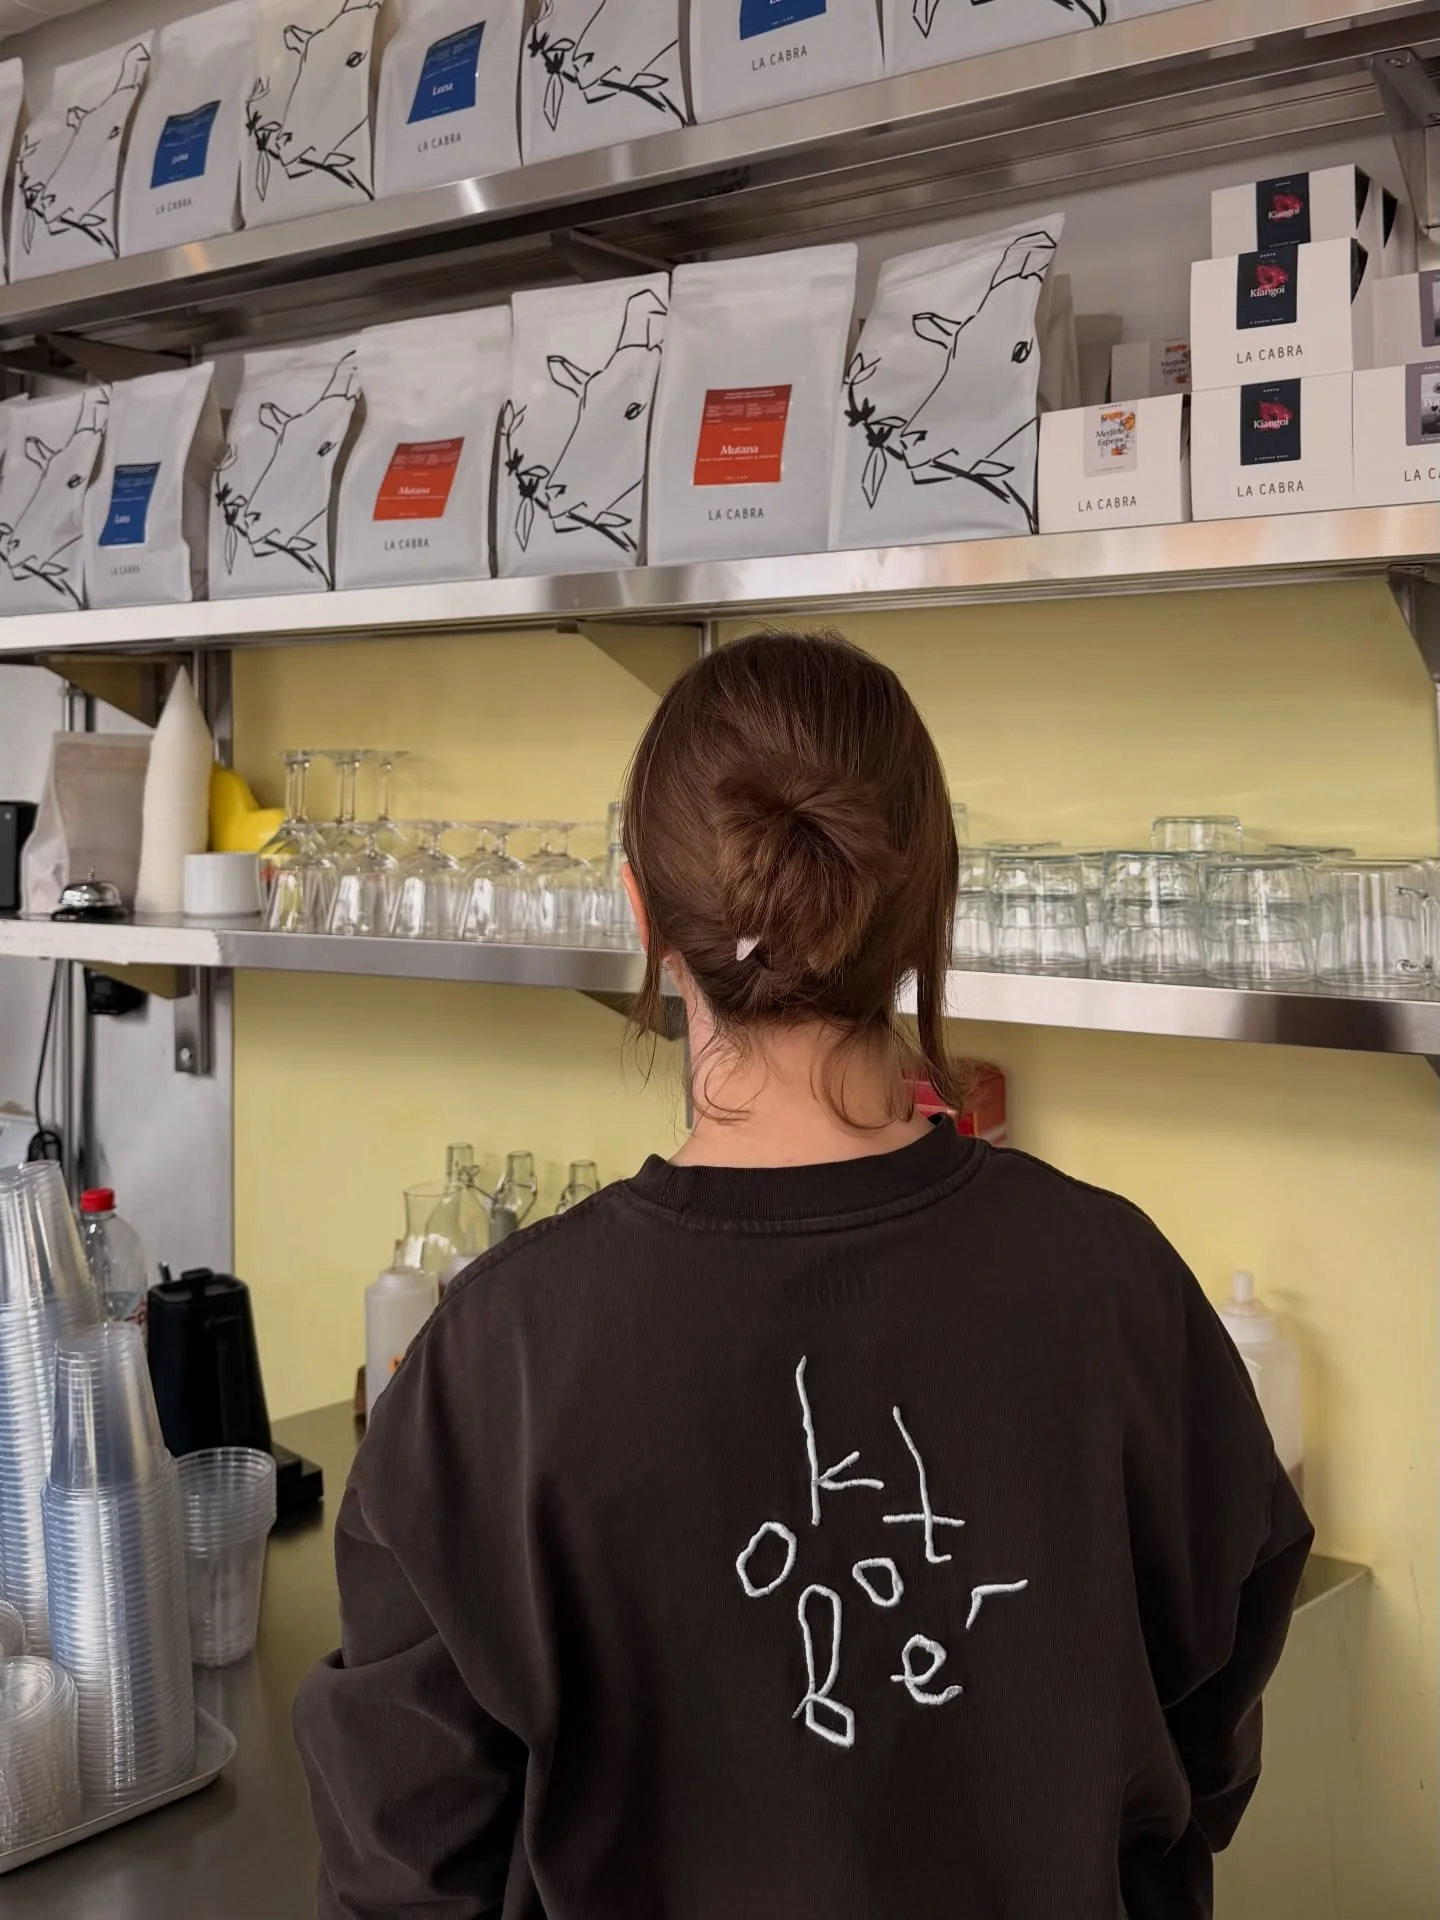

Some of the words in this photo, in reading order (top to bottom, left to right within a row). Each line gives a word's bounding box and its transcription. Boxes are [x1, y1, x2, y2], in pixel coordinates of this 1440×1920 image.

[752, 57, 766, 71] LA
[770, 45, 808, 66] CABRA
[418, 141, 428, 152] LA
[432, 132, 462, 149] CABRA
[1268, 206, 1300, 219] Kiangoi
[1250, 285, 1285, 298] Kiangoi
[1236, 352, 1253, 364] LA
[1258, 345, 1304, 361] CABRA
[1253, 416, 1289, 429] Kiangoi
[720, 445, 760, 456] Mutana
[1404, 469, 1421, 482] LA
[1237, 485, 1253, 498] LA
[1259, 480, 1304, 495] CABRA
[1078, 501, 1092, 512] LA
[1098, 496, 1137, 510] CABRA
[708, 509, 721, 521] LA
[726, 507, 765, 520] CABRA
[384, 540, 396, 552] LA
[399, 537, 430, 550] CABRA
